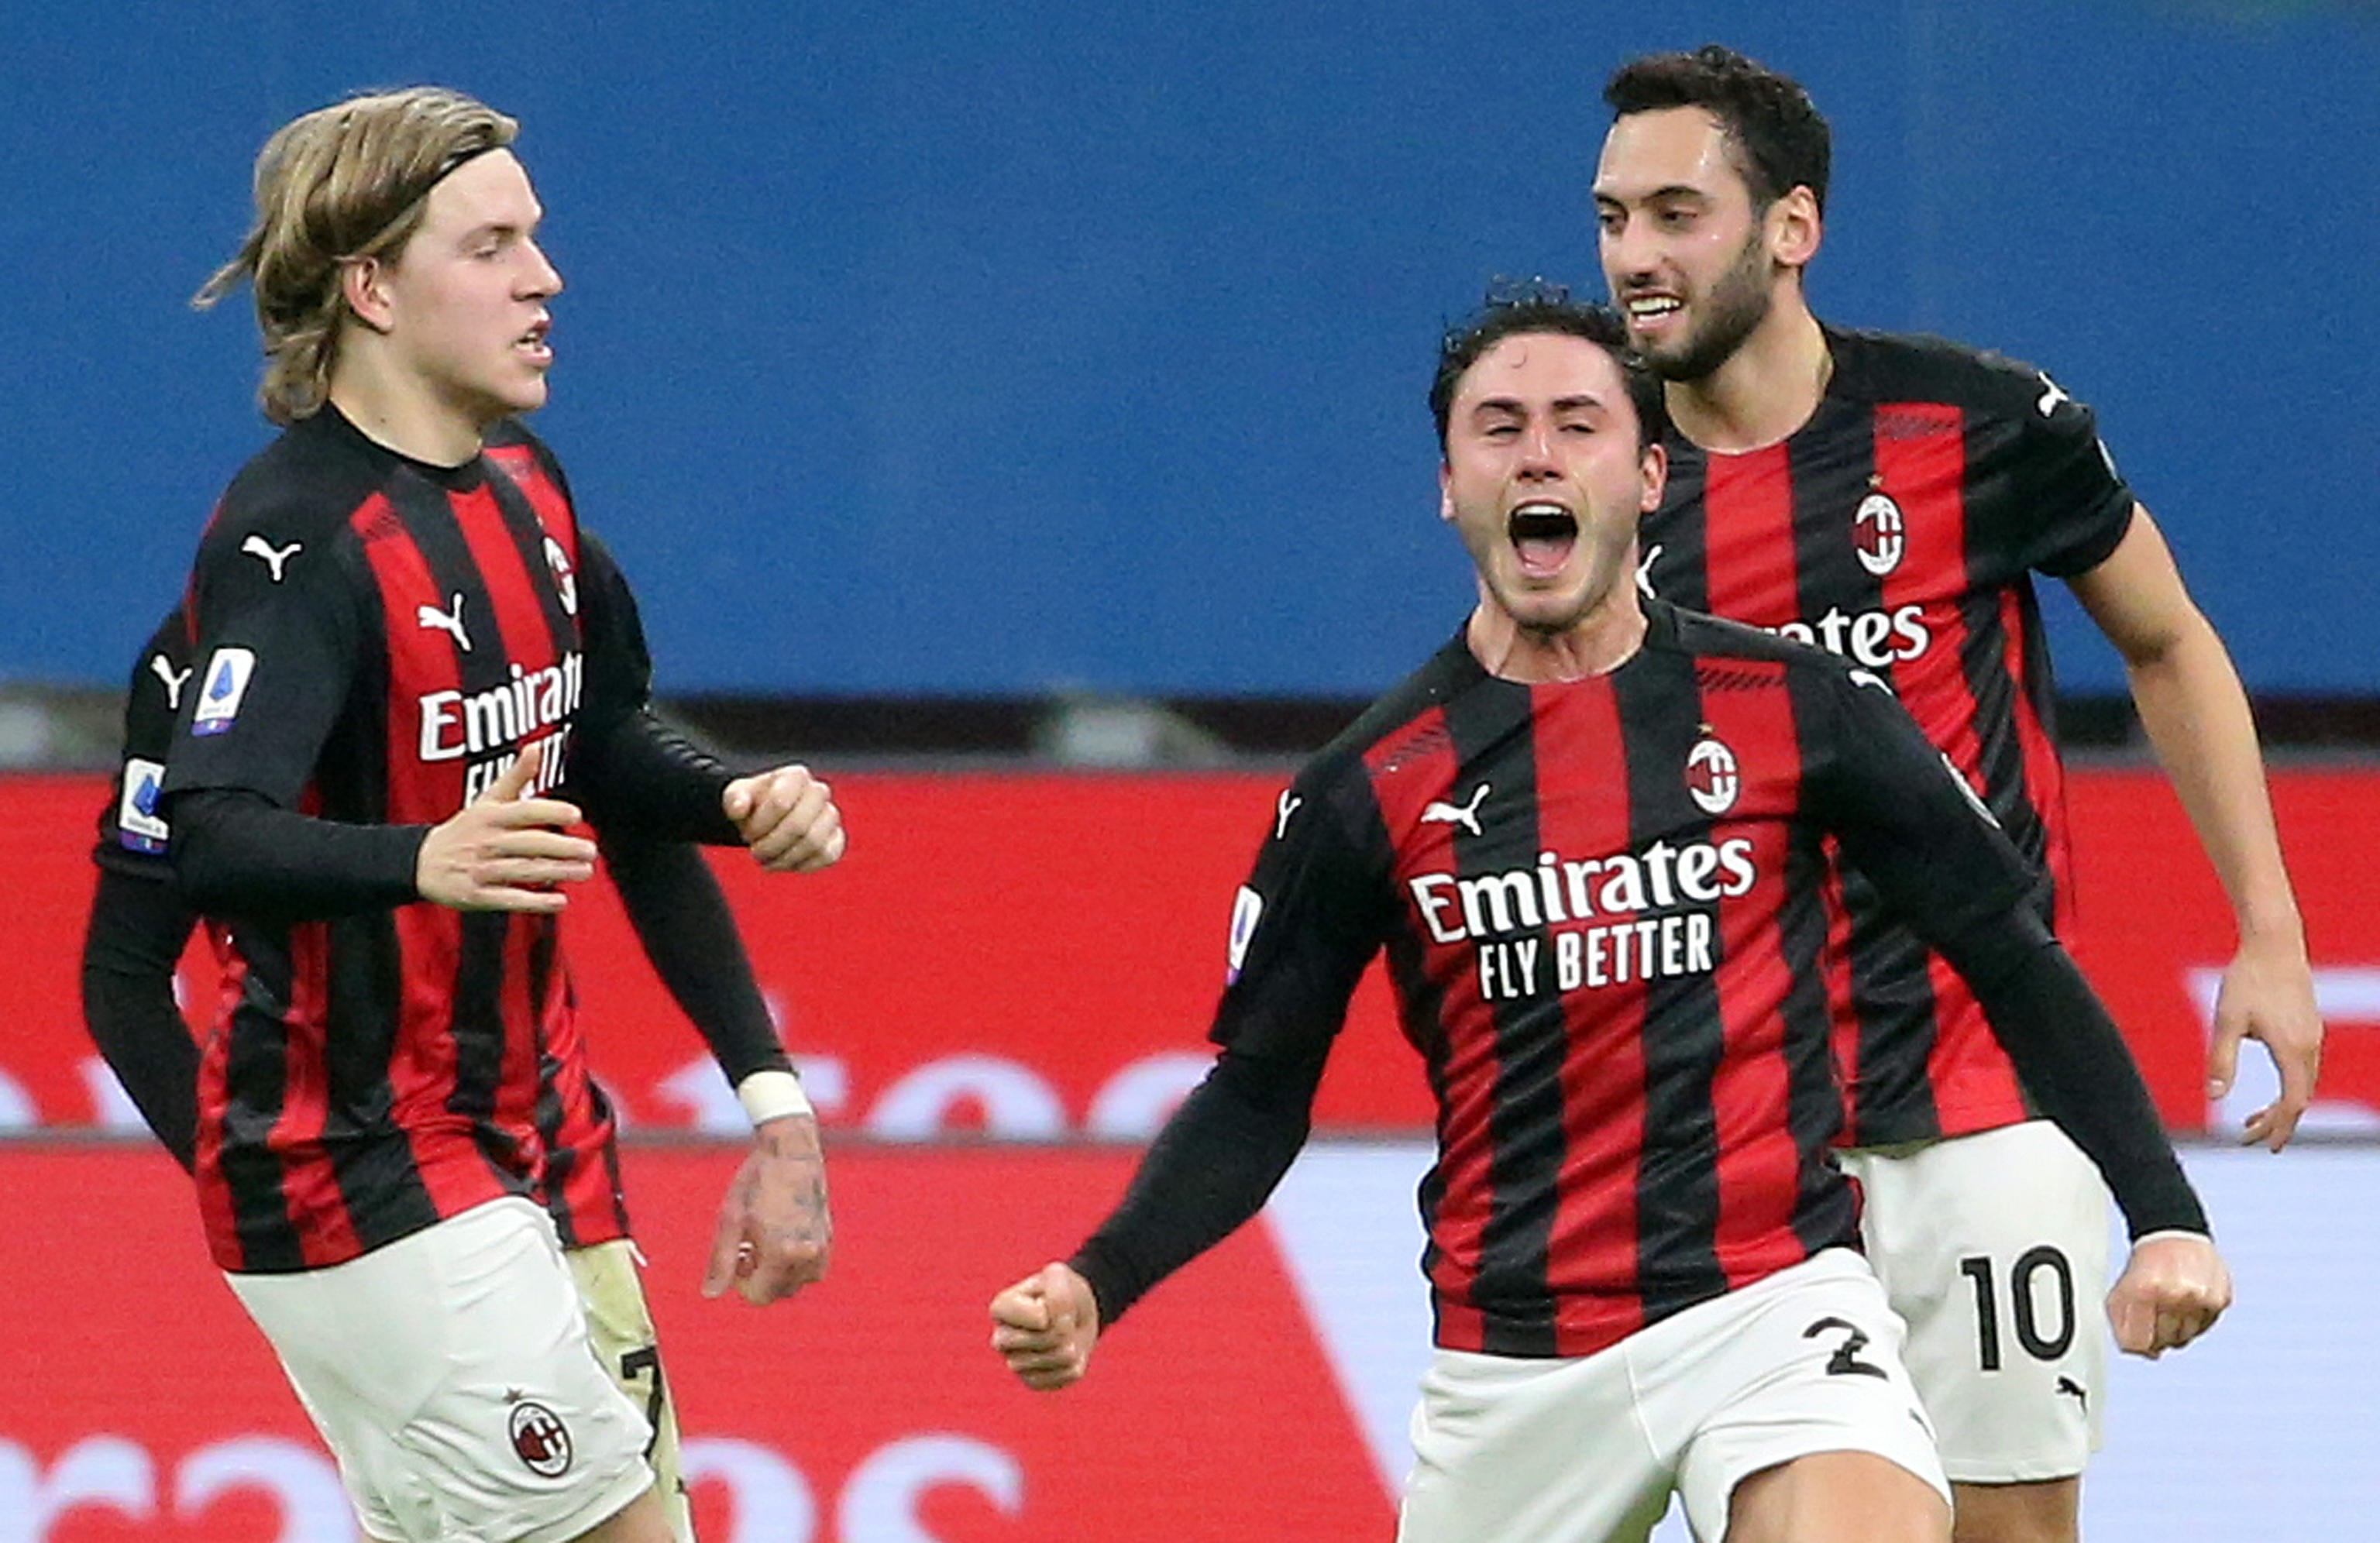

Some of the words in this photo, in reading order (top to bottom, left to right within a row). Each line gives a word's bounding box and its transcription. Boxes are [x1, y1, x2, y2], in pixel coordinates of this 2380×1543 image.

[1410, 838, 1754, 943] Emirates
[1479, 939, 1539, 999] FLY
[1556, 913, 1712, 990] BETTER
[1803, 1316, 1888, 1380] 2
[1961, 1245, 2076, 1372] 10
[621, 1346, 663, 1460] 7
